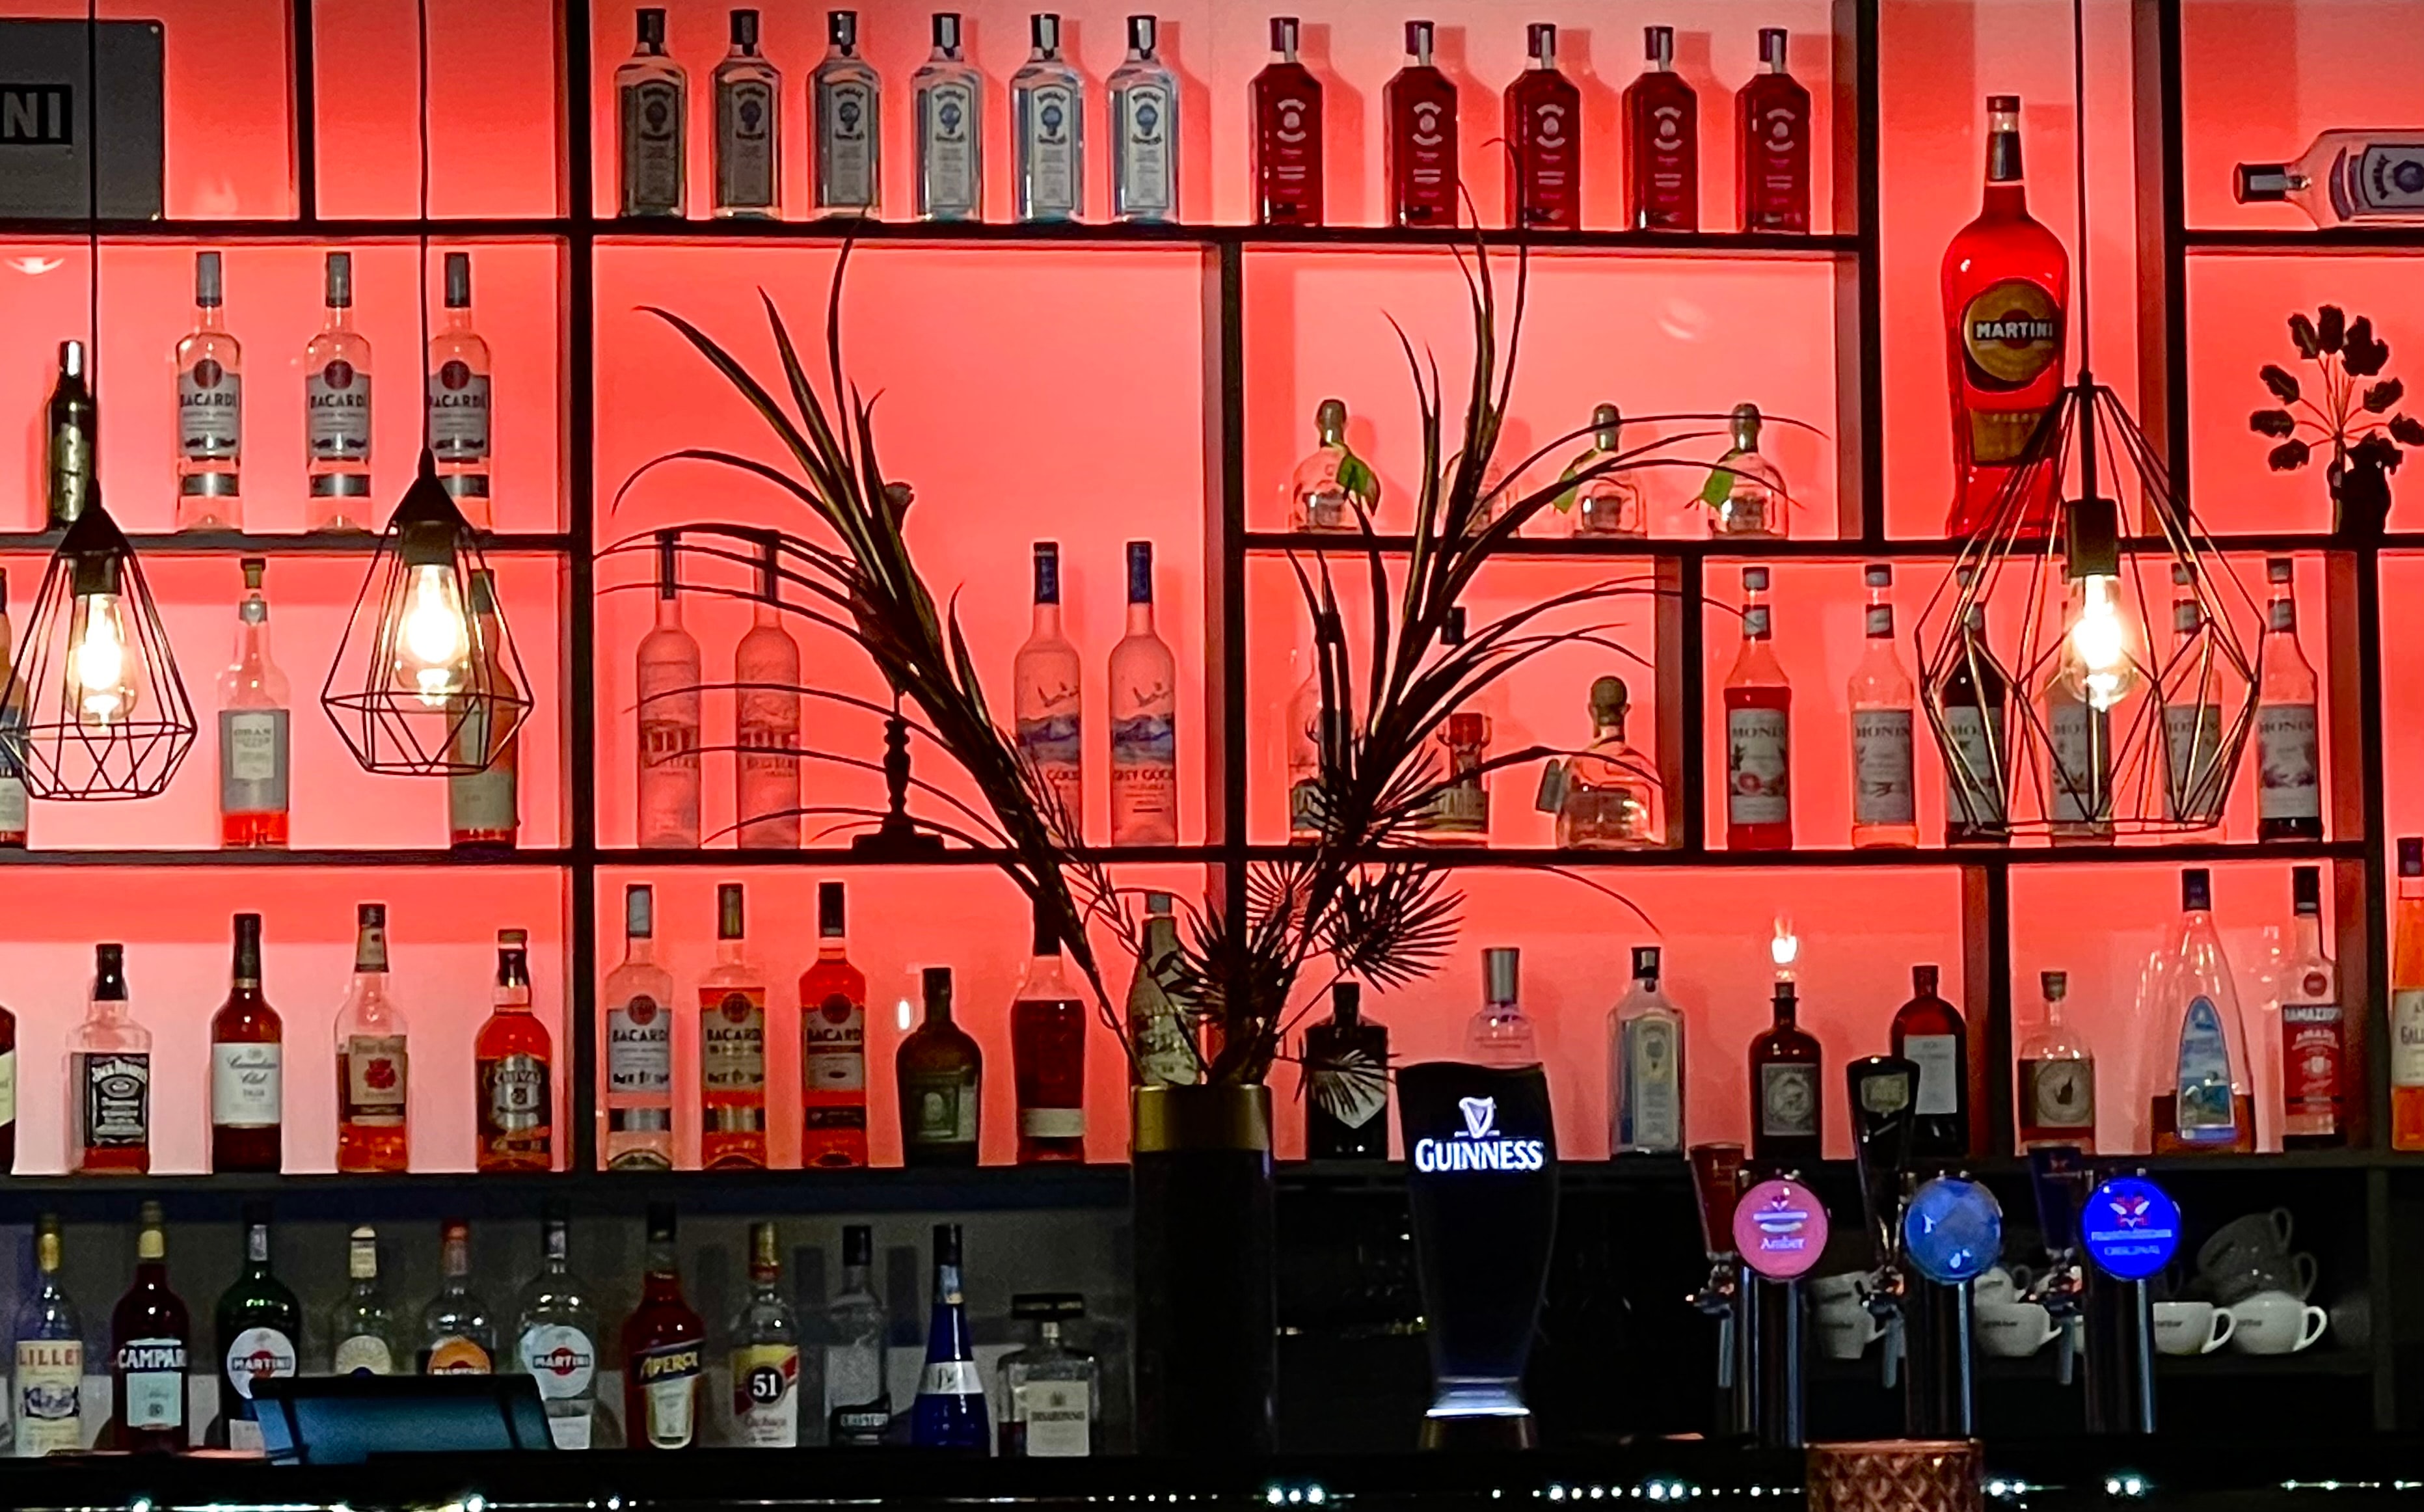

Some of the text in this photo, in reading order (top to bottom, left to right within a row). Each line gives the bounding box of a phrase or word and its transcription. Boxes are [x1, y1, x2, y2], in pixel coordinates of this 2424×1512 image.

[3, 92, 61, 139] NI
[1975, 321, 2053, 338] MARTINI
[1415, 1139, 1544, 1172] GUINNESS
[1760, 1237, 1804, 1250] Amber
[640, 1351, 699, 1379] APEROL
[752, 1373, 777, 1397] 51
